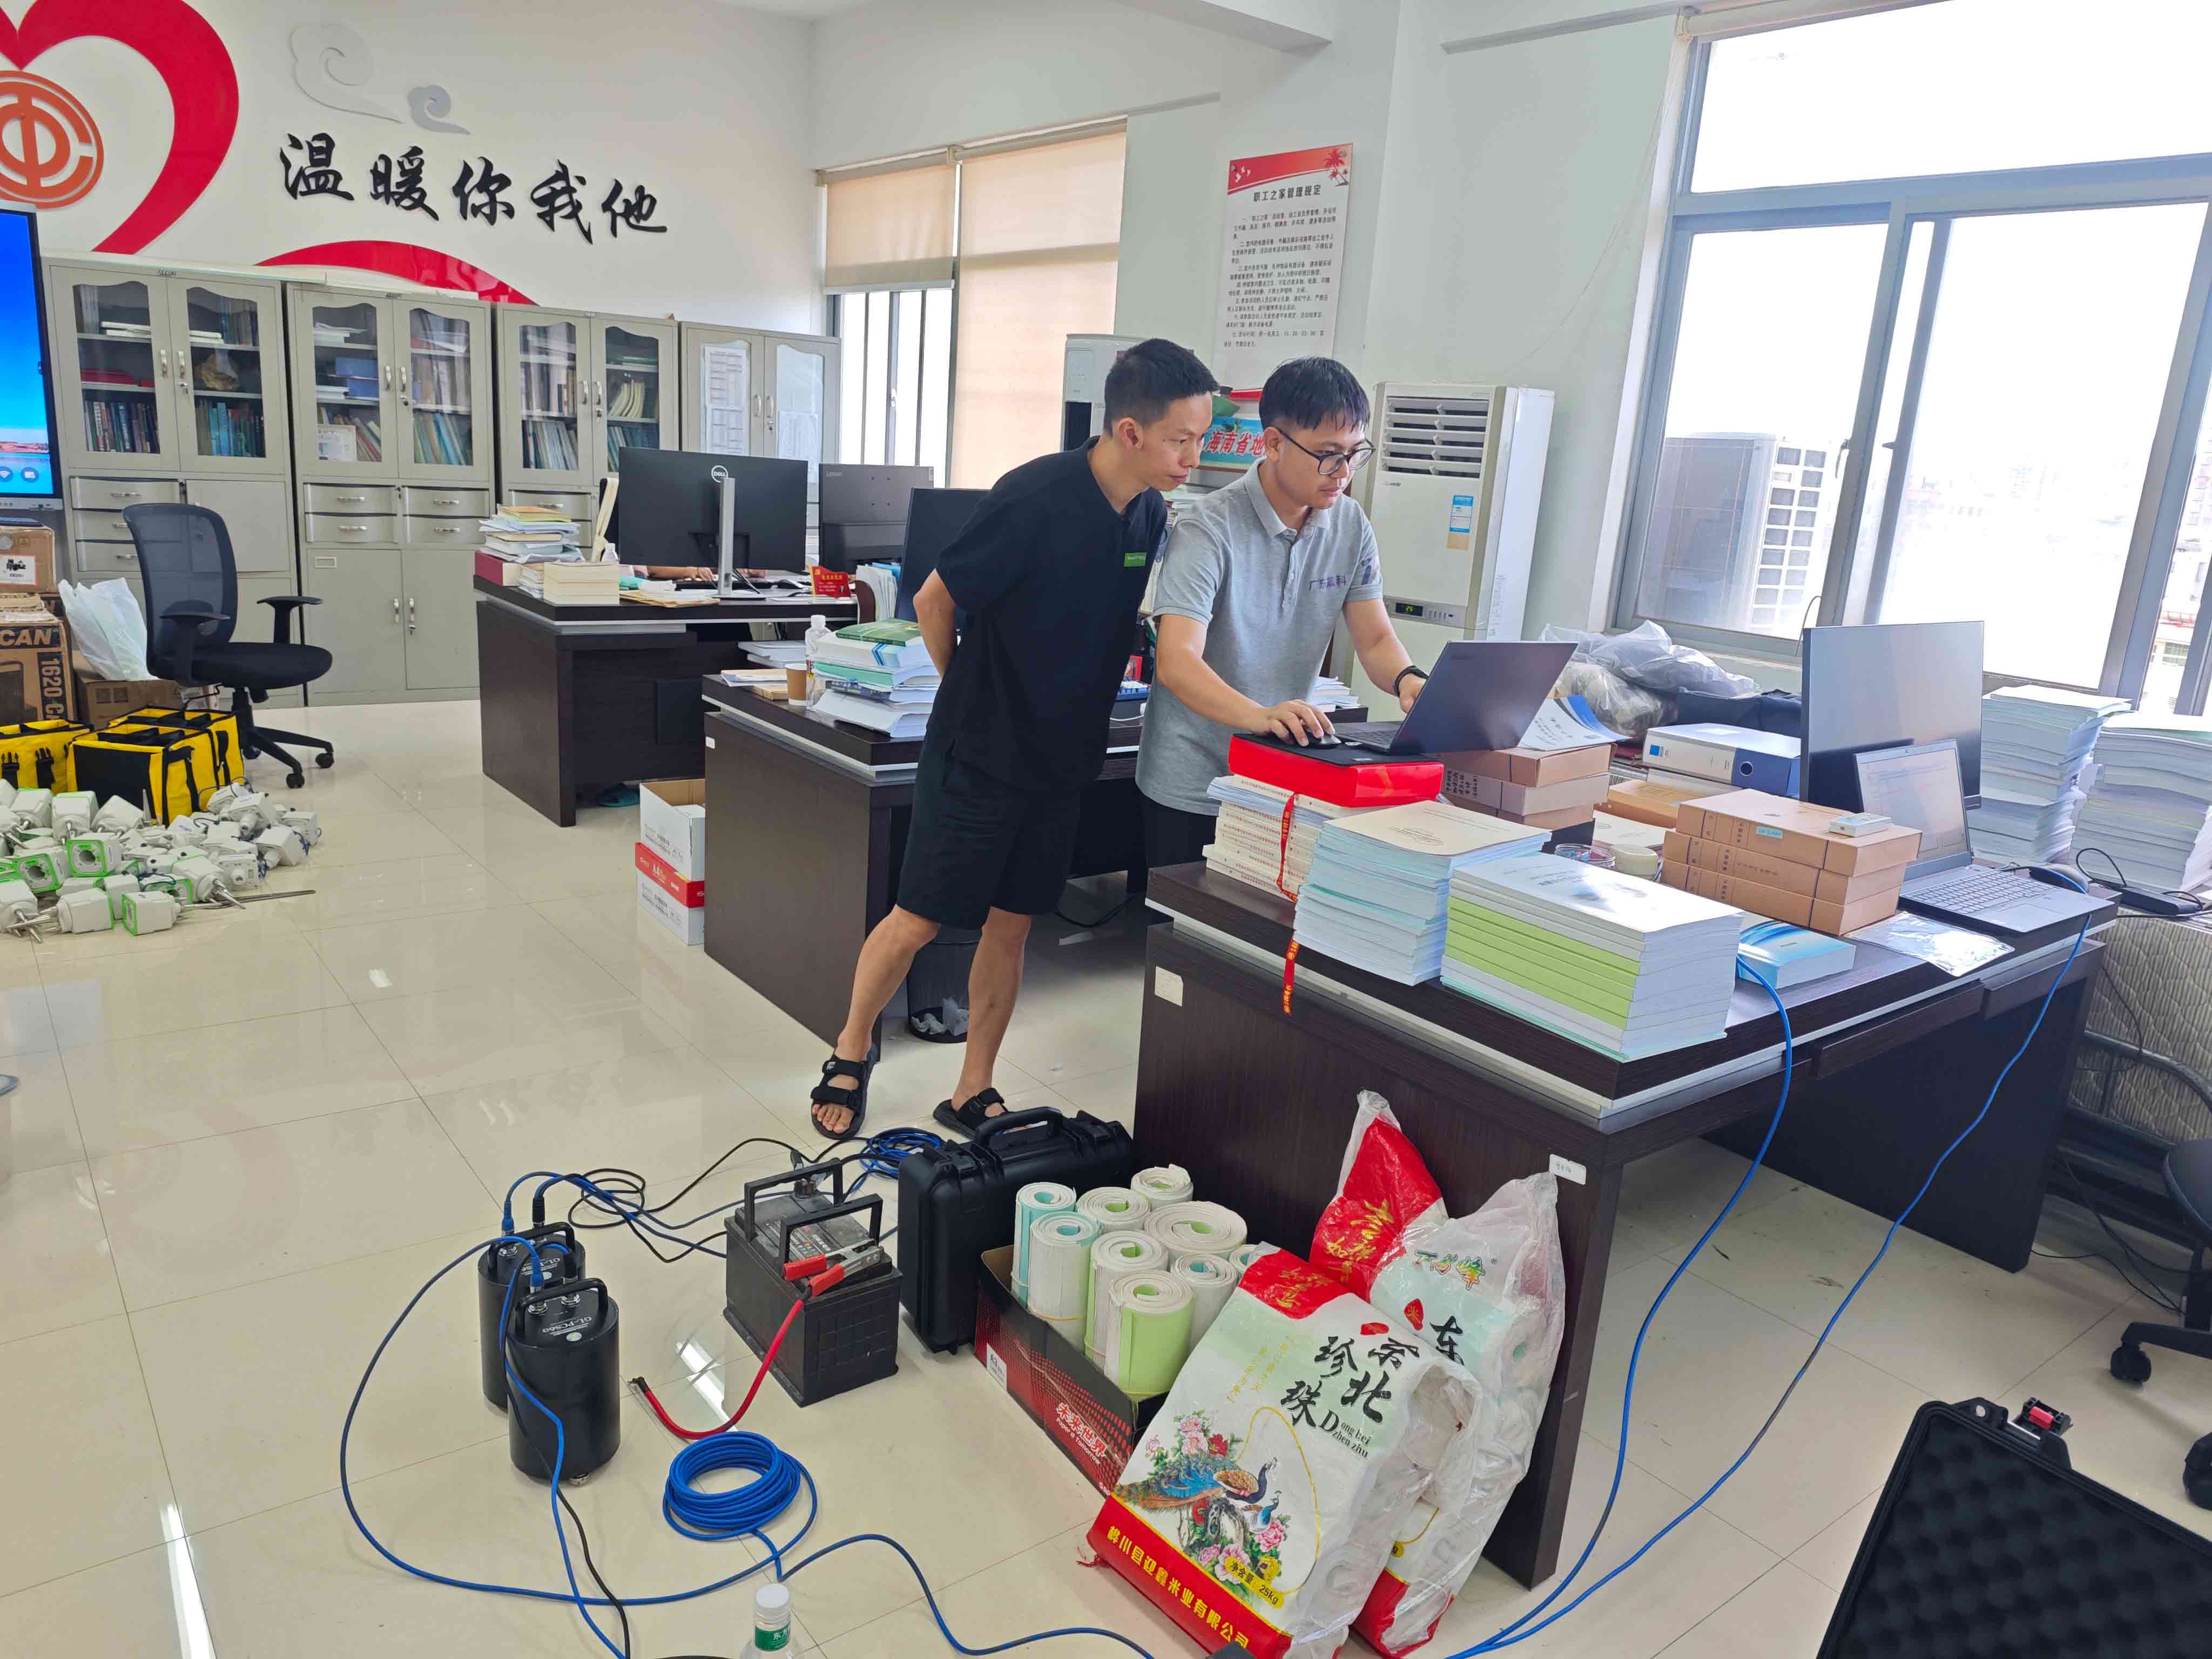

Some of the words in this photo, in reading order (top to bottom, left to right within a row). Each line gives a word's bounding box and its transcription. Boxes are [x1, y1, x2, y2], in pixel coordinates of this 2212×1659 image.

[280, 132, 667, 245] 温暖你我他
[1253, 184, 1321, 202] 职工之家管理规定
[41, 658, 63, 698] 1620
[1056, 1402, 1107, 1458] 未来世界
[1075, 1437, 1101, 1465] Tomorrow
[1230, 1561, 1254, 1585] 净含量
[1258, 1584, 1279, 1606] 25kg
